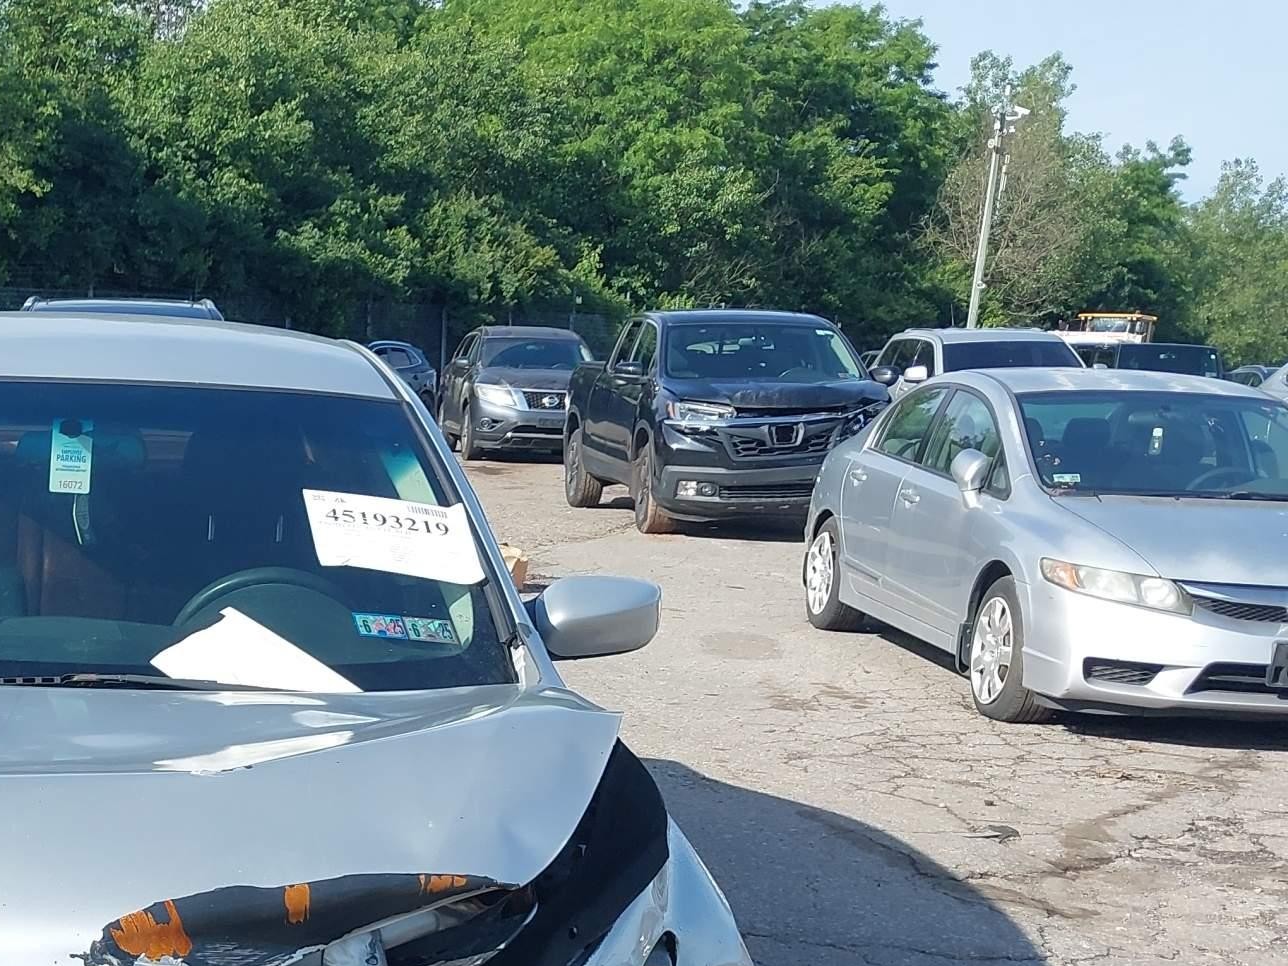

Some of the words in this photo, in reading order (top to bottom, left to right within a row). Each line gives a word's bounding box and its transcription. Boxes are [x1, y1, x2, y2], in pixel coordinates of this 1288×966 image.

[56, 454, 87, 463] PARKING
[59, 480, 82, 490] 16072
[325, 508, 449, 536] 45193219
